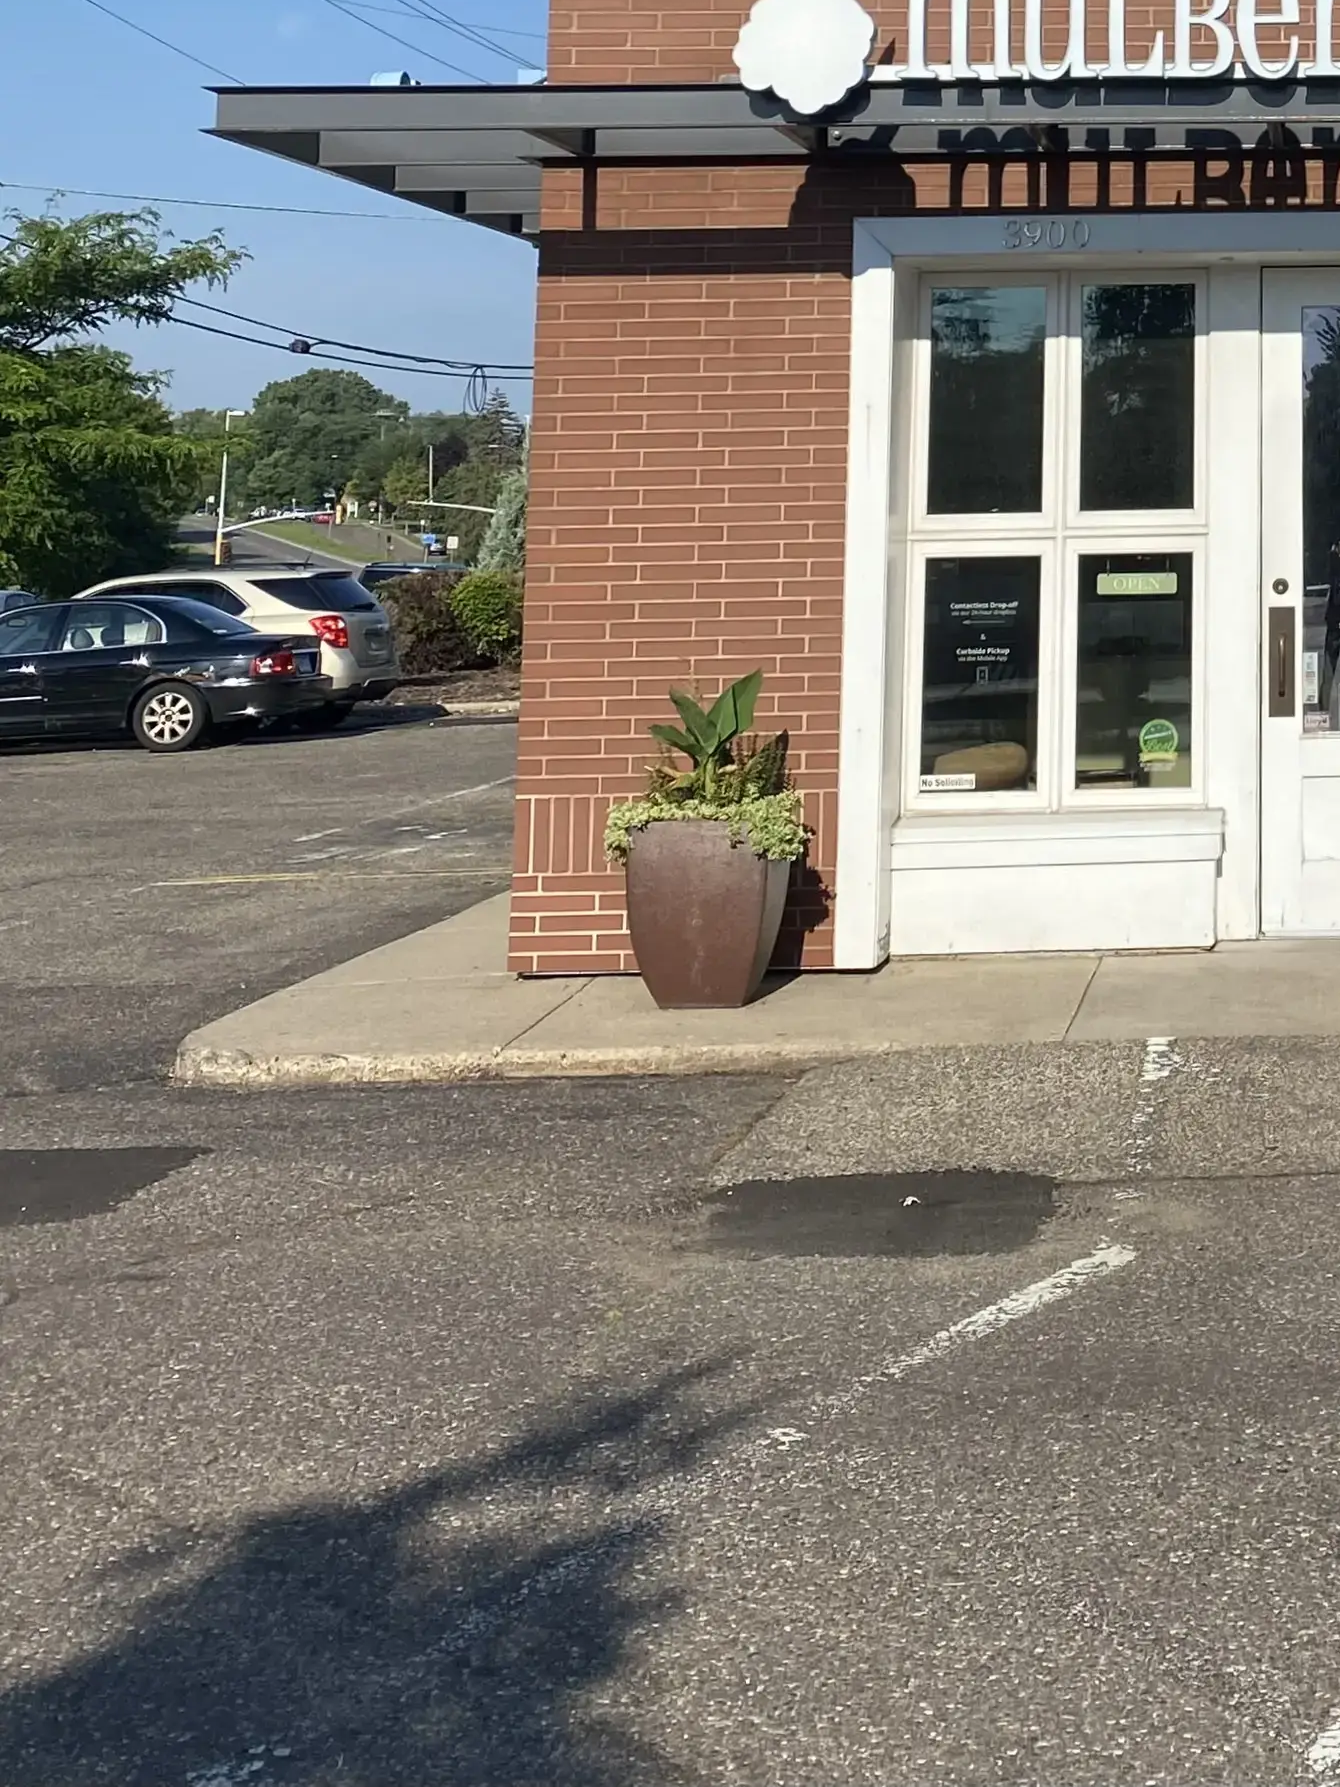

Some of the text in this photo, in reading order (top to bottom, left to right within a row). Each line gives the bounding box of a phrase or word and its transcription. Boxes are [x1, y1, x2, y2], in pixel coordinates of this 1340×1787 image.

[1001, 219, 1091, 250] 3900
[1112, 576, 1161, 591] OPEN
[990, 601, 1019, 609] Drop-off
[956, 647, 986, 655] Curbside
[921, 777, 933, 788] No
